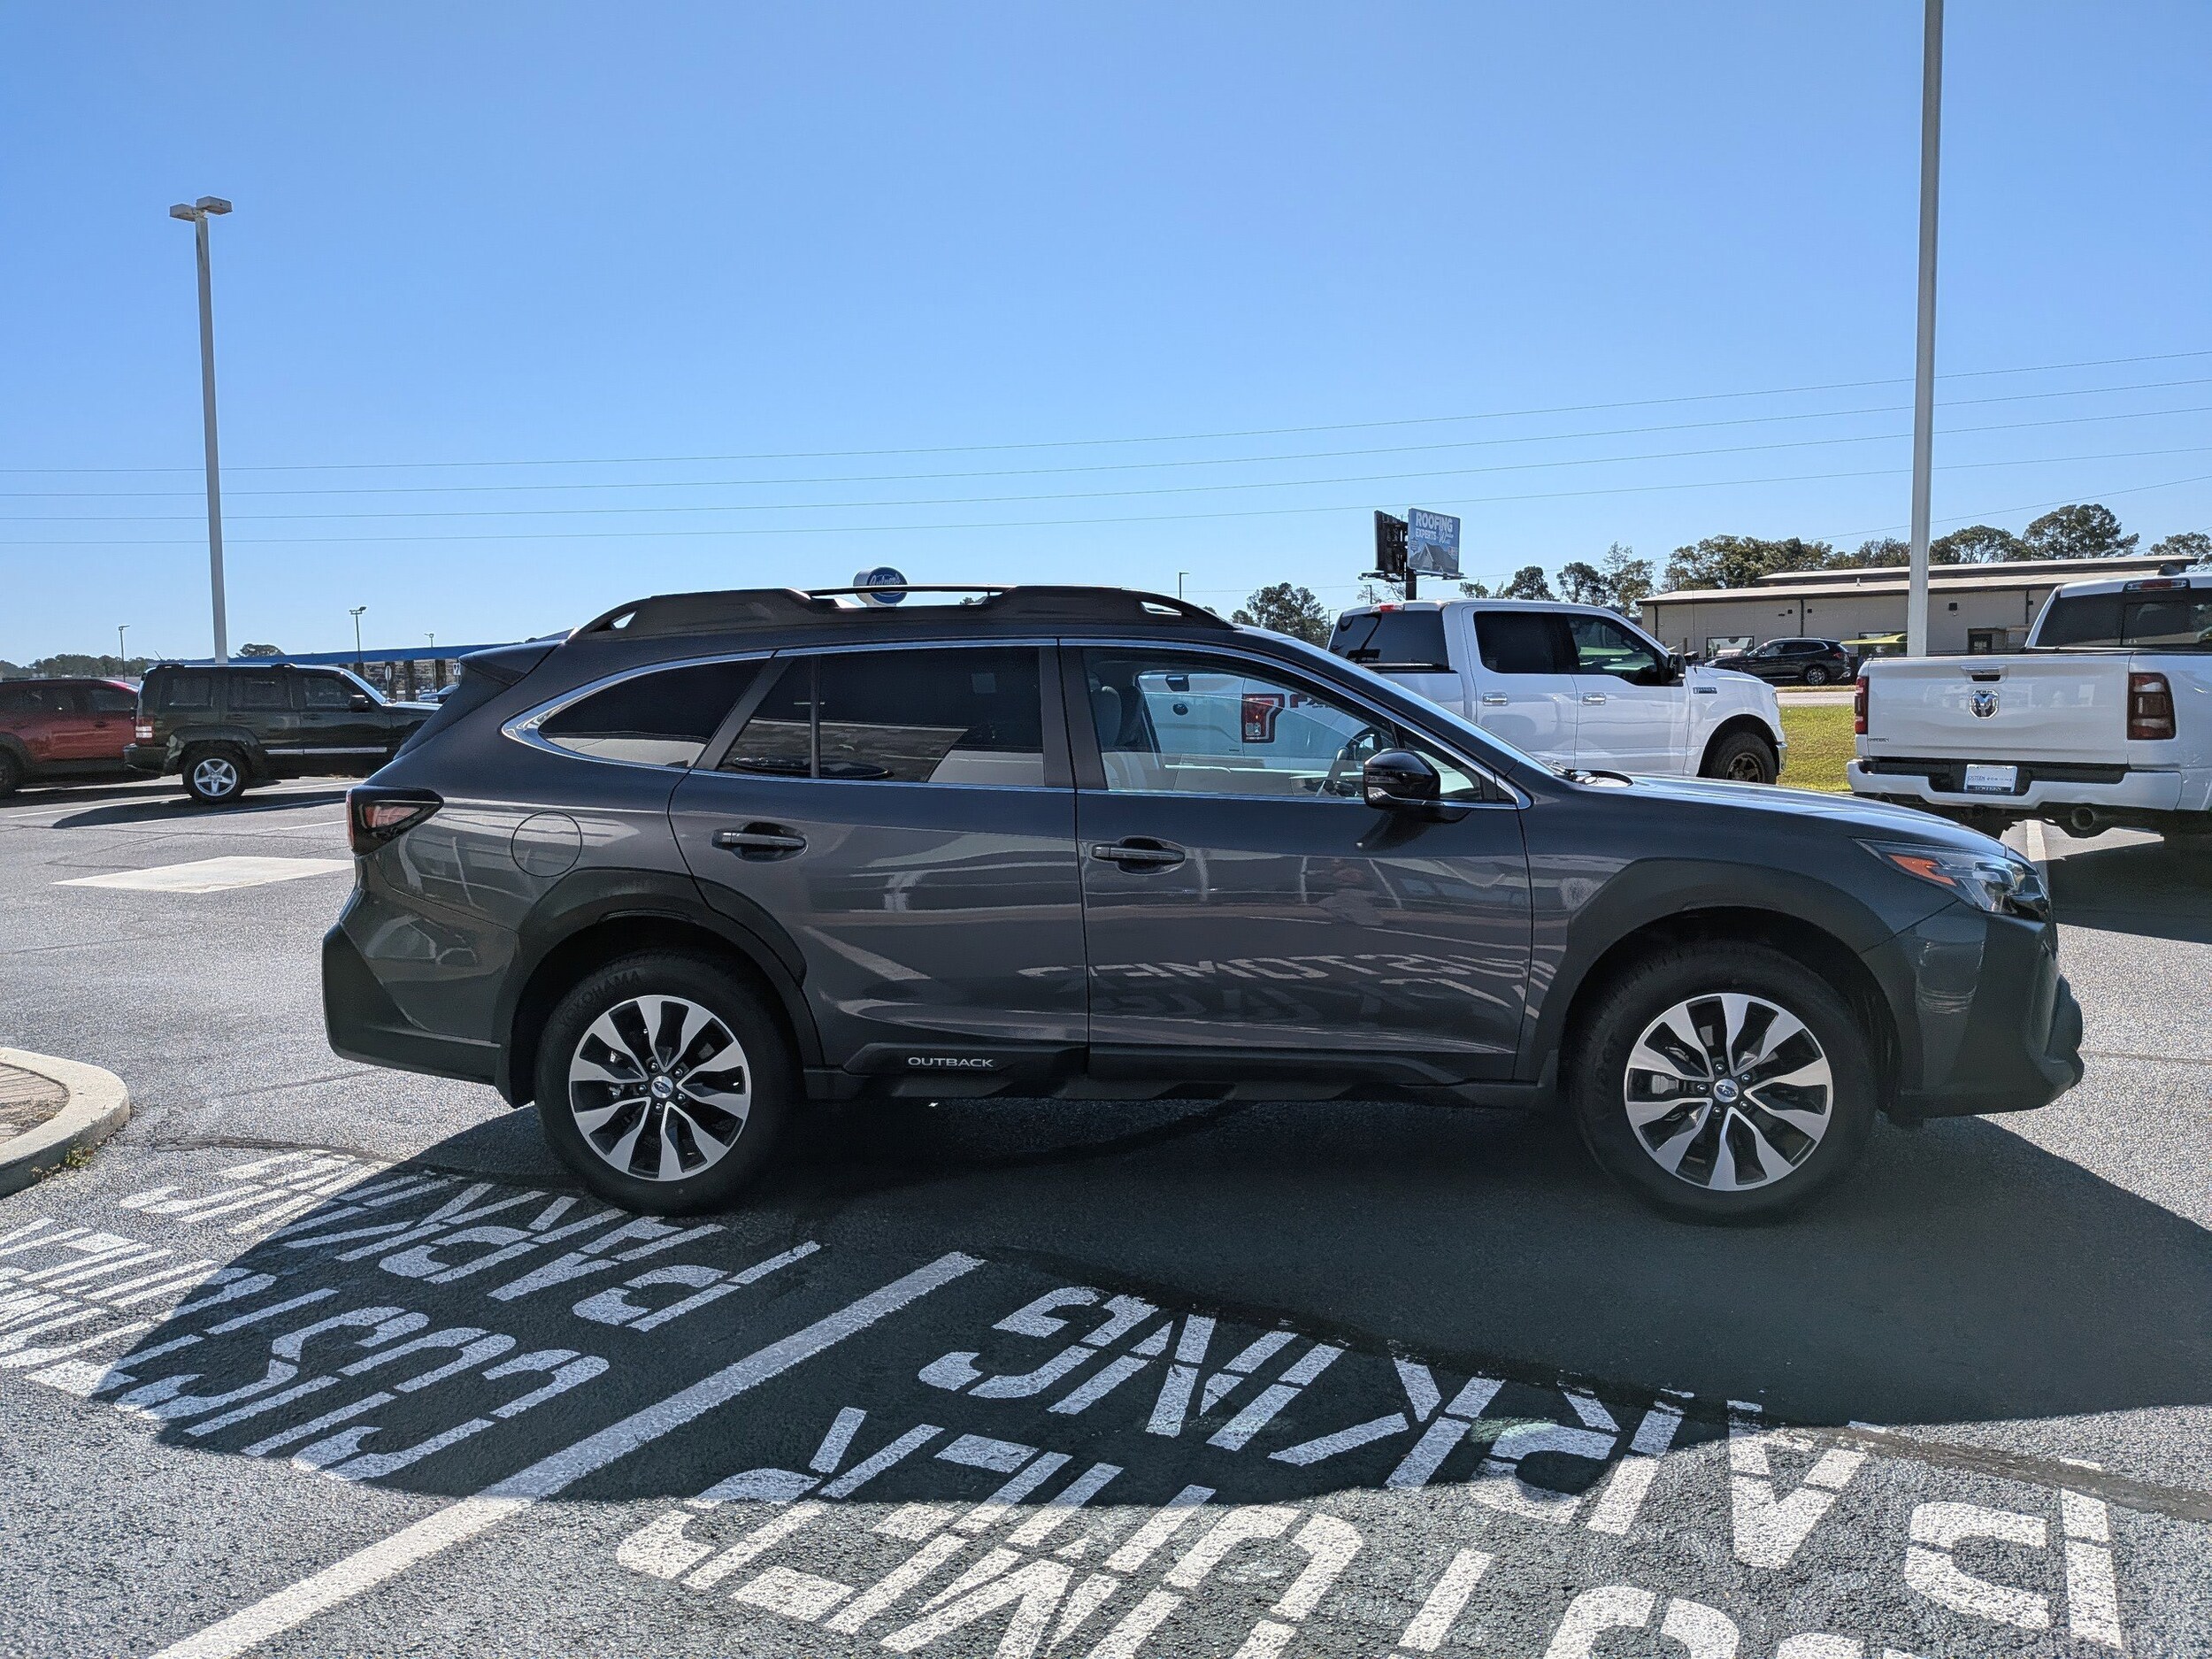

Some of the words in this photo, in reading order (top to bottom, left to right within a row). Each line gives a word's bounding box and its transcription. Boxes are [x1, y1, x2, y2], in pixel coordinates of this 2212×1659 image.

[1416, 513, 1453, 533] ROOFING
[1416, 528, 1437, 541] EXPERTS
[907, 1056, 994, 1068] OUTBACK
[119, 1150, 822, 1332] PARKING
[918, 1286, 2123, 1647] PARKING
